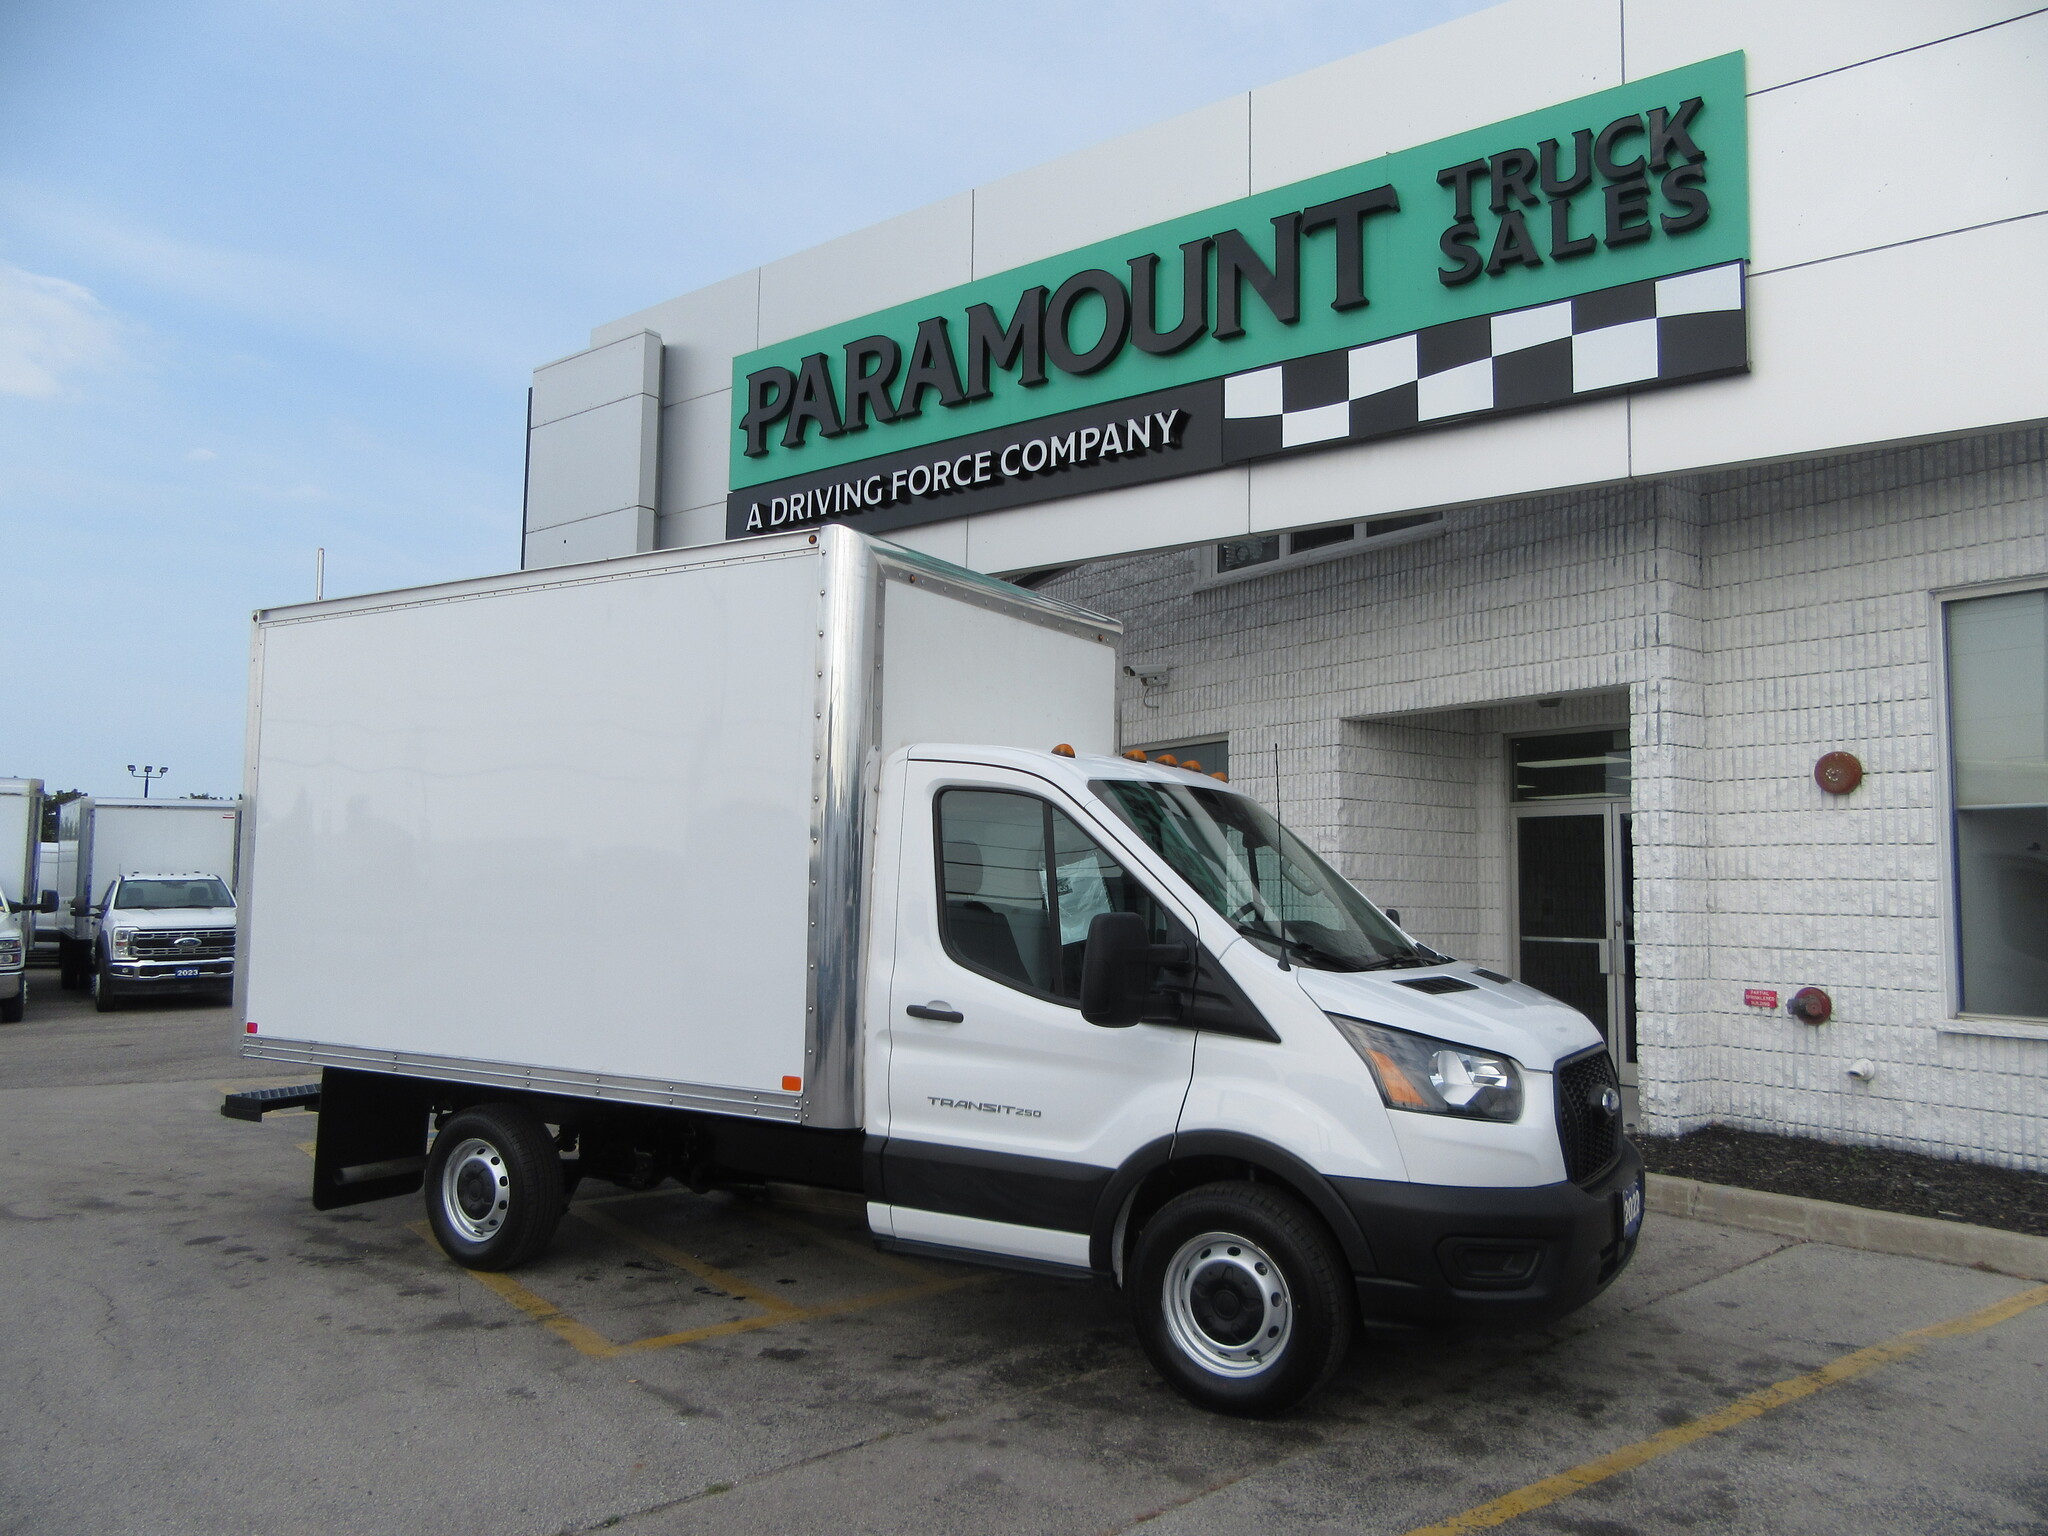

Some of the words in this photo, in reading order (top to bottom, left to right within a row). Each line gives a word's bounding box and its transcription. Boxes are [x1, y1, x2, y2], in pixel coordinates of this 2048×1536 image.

[1436, 96, 1707, 225] TRUCK
[1438, 164, 1711, 287] SALES
[739, 183, 1401, 458] PARAMOUNT
[745, 502, 764, 532] A
[769, 474, 883, 526] DRIVING
[891, 450, 993, 501] FORCE
[999, 408, 1181, 478] COMPANY
